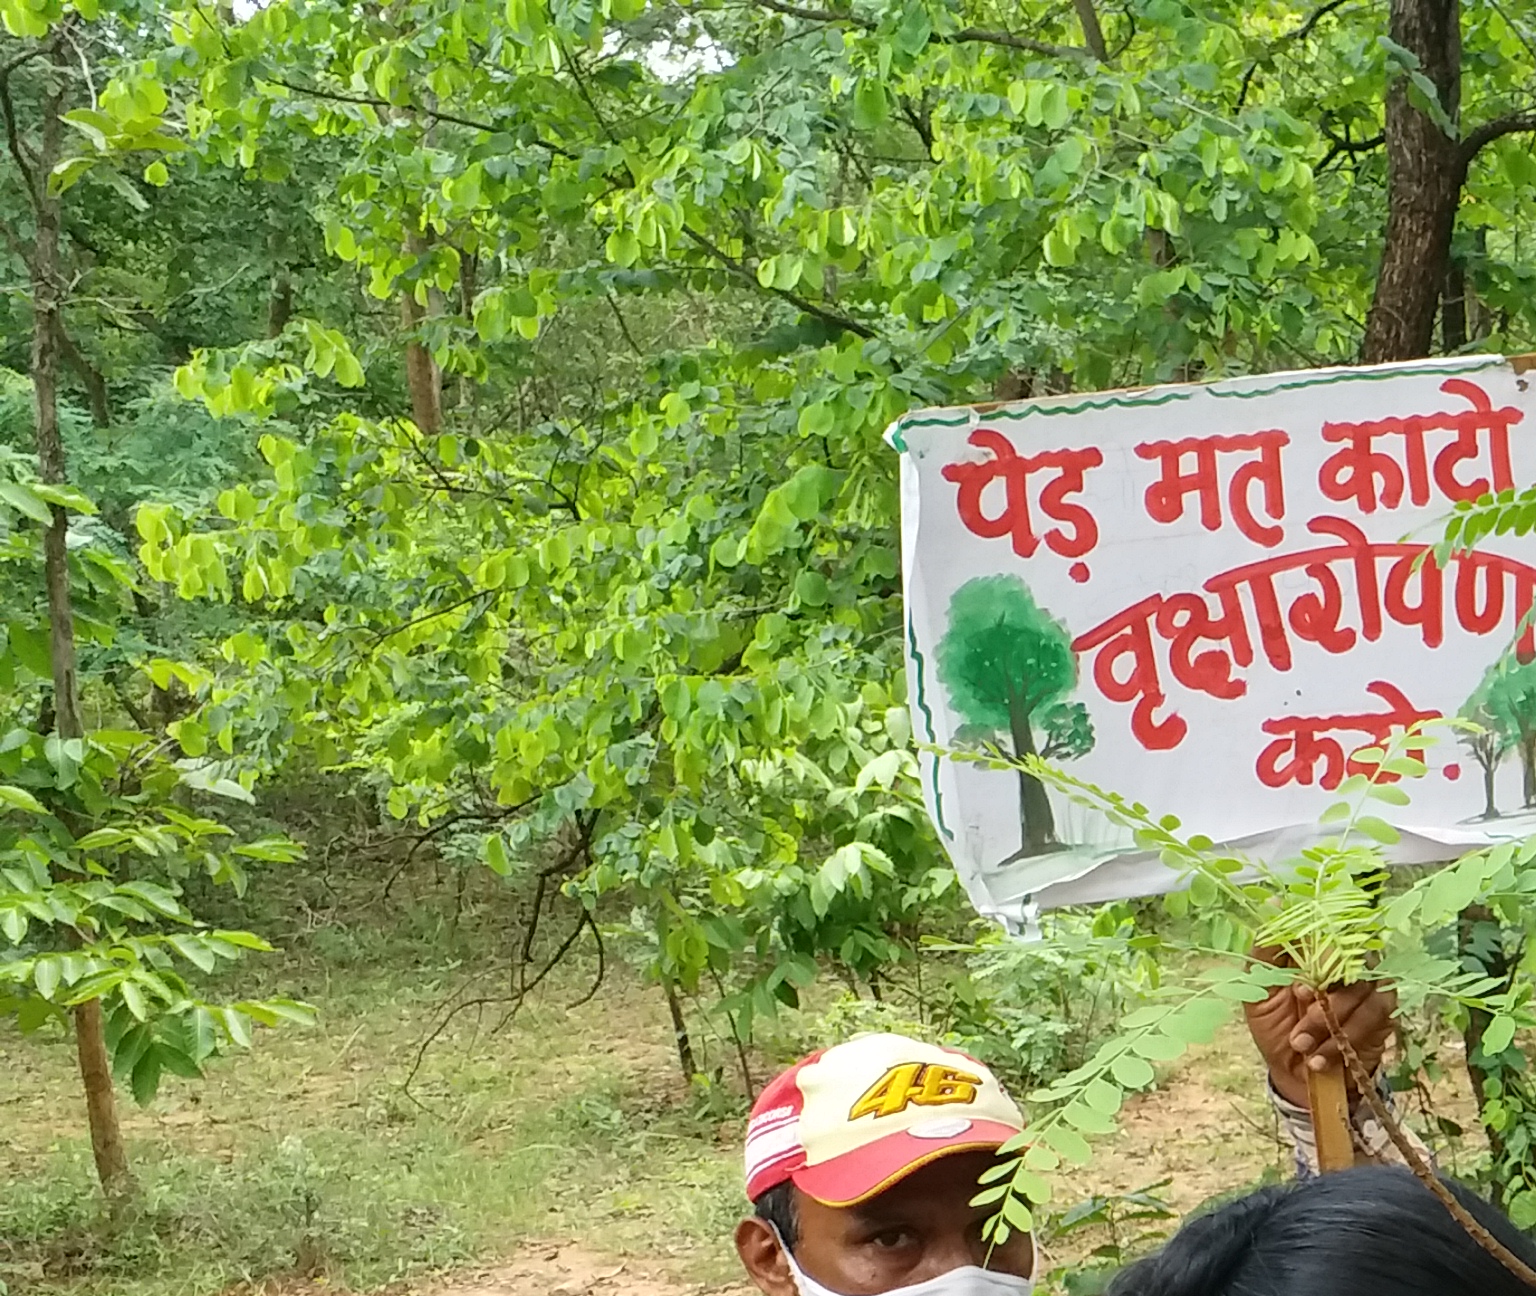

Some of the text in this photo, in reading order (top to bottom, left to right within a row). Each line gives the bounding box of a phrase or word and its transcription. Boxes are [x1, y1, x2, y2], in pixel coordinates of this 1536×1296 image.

[941, 378, 1524, 584] पेड़ मत काटो
[847, 1062, 983, 1121] 46
